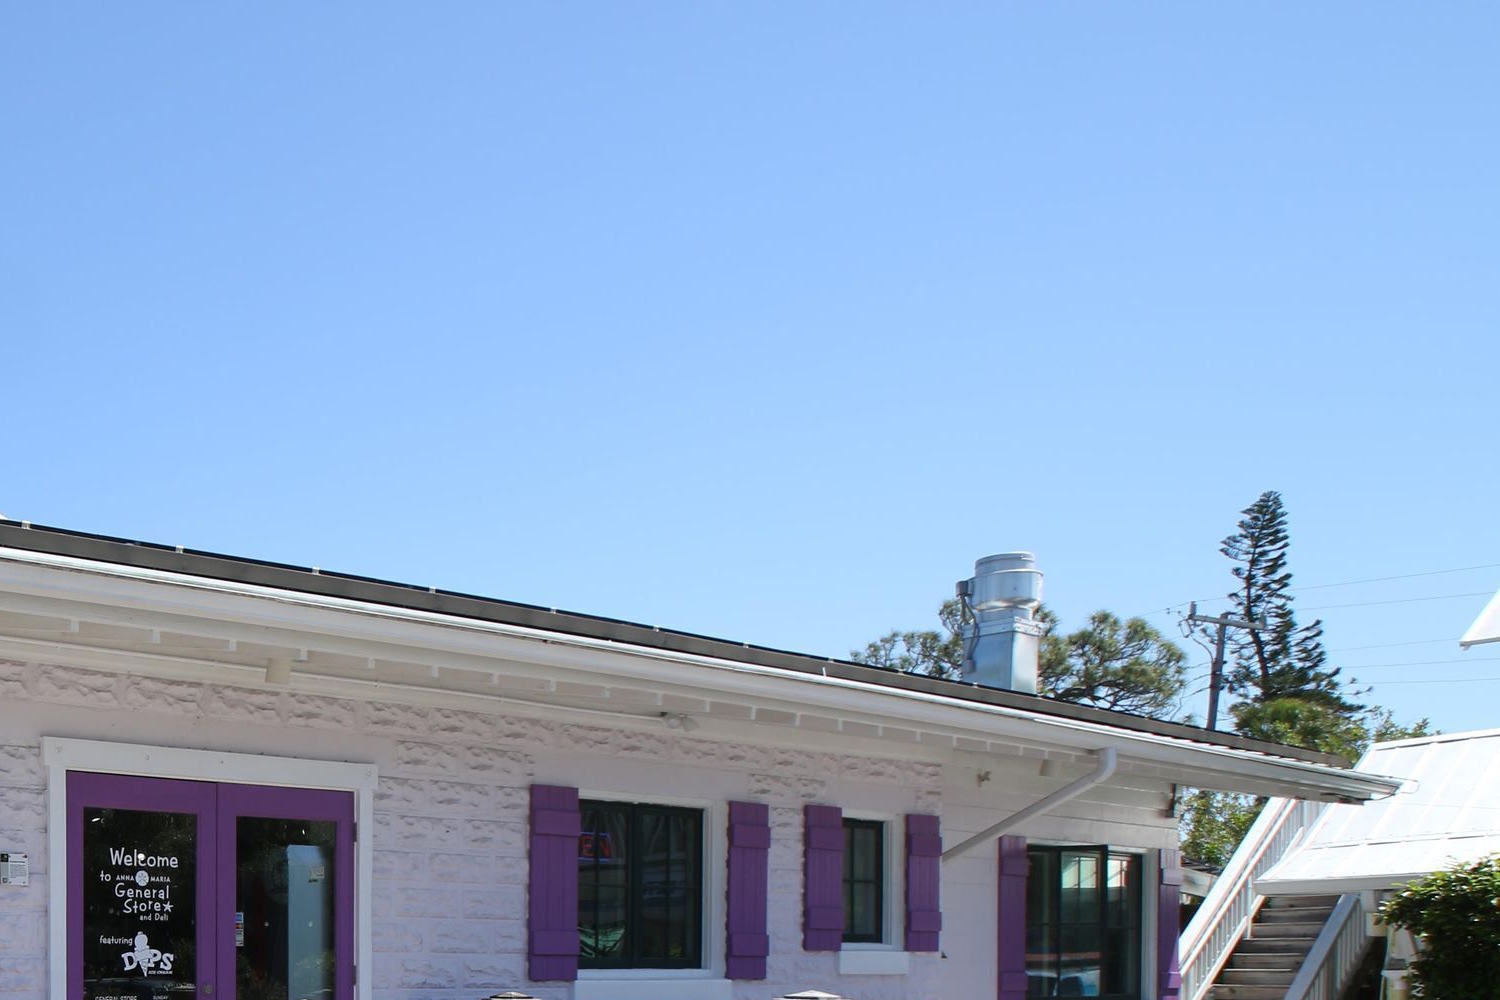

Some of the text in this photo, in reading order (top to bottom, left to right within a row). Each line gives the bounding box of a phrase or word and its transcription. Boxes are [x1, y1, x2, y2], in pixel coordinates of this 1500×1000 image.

[109, 847, 179, 868] Welcome
[100, 870, 111, 881] to
[115, 882, 169, 899] General
[123, 899, 161, 914] Store
[155, 913, 169, 921] Deli
[100, 935, 133, 946] featuring
